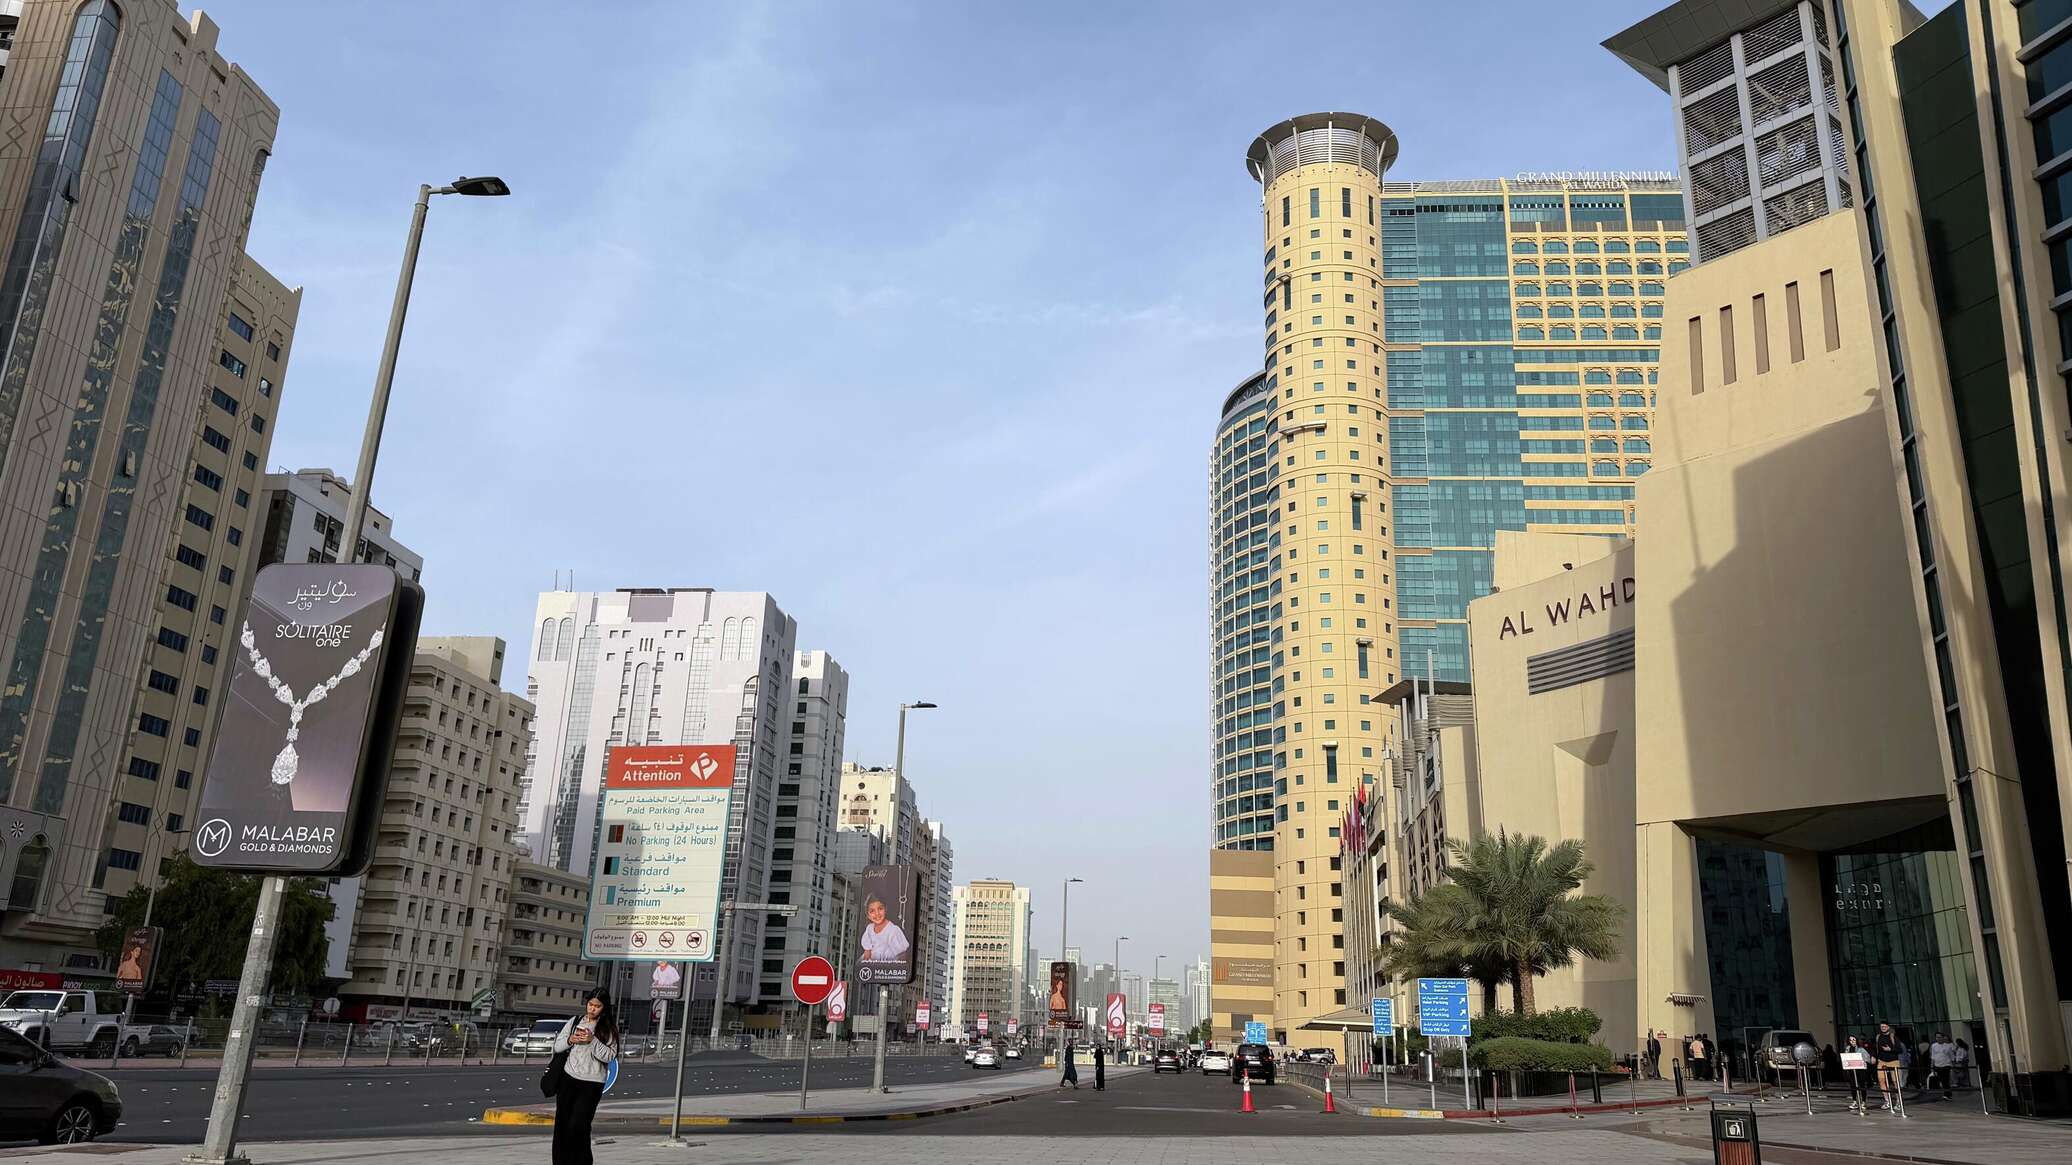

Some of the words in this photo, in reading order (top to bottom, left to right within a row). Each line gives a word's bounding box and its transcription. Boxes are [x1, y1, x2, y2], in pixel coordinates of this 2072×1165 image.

[1517, 171, 1571, 183] GRAND
[1579, 170, 1672, 182] MILLENNIUM
[1582, 181, 1628, 190] WAHDA
[297, 601, 313, 611] ون
[275, 623, 352, 639] SOLITAIRE
[1499, 611, 1534, 641] AL
[315, 637, 341, 647] one
[624, 753, 684, 769] تنبيه
[622, 770, 682, 782] Attention
[626, 807, 645, 815] Paid
[649, 806, 681, 816] Parking
[684, 806, 705, 814] Area
[241, 825, 336, 843] MALABAR
[625, 835, 637, 846] No
[640, 835, 670, 847] Parking
[673, 835, 687, 845] (24
[690, 835, 717, 846] Hours)
[239, 842, 268, 852] GOLD
[269, 843, 276, 852] &
[277, 844, 333, 854] DIAMONDS
[653, 853, 687, 864] مواقف
[621, 867, 670, 876] Standard
[653, 883, 686, 895] مواقف
[616, 897, 661, 907] Premium
